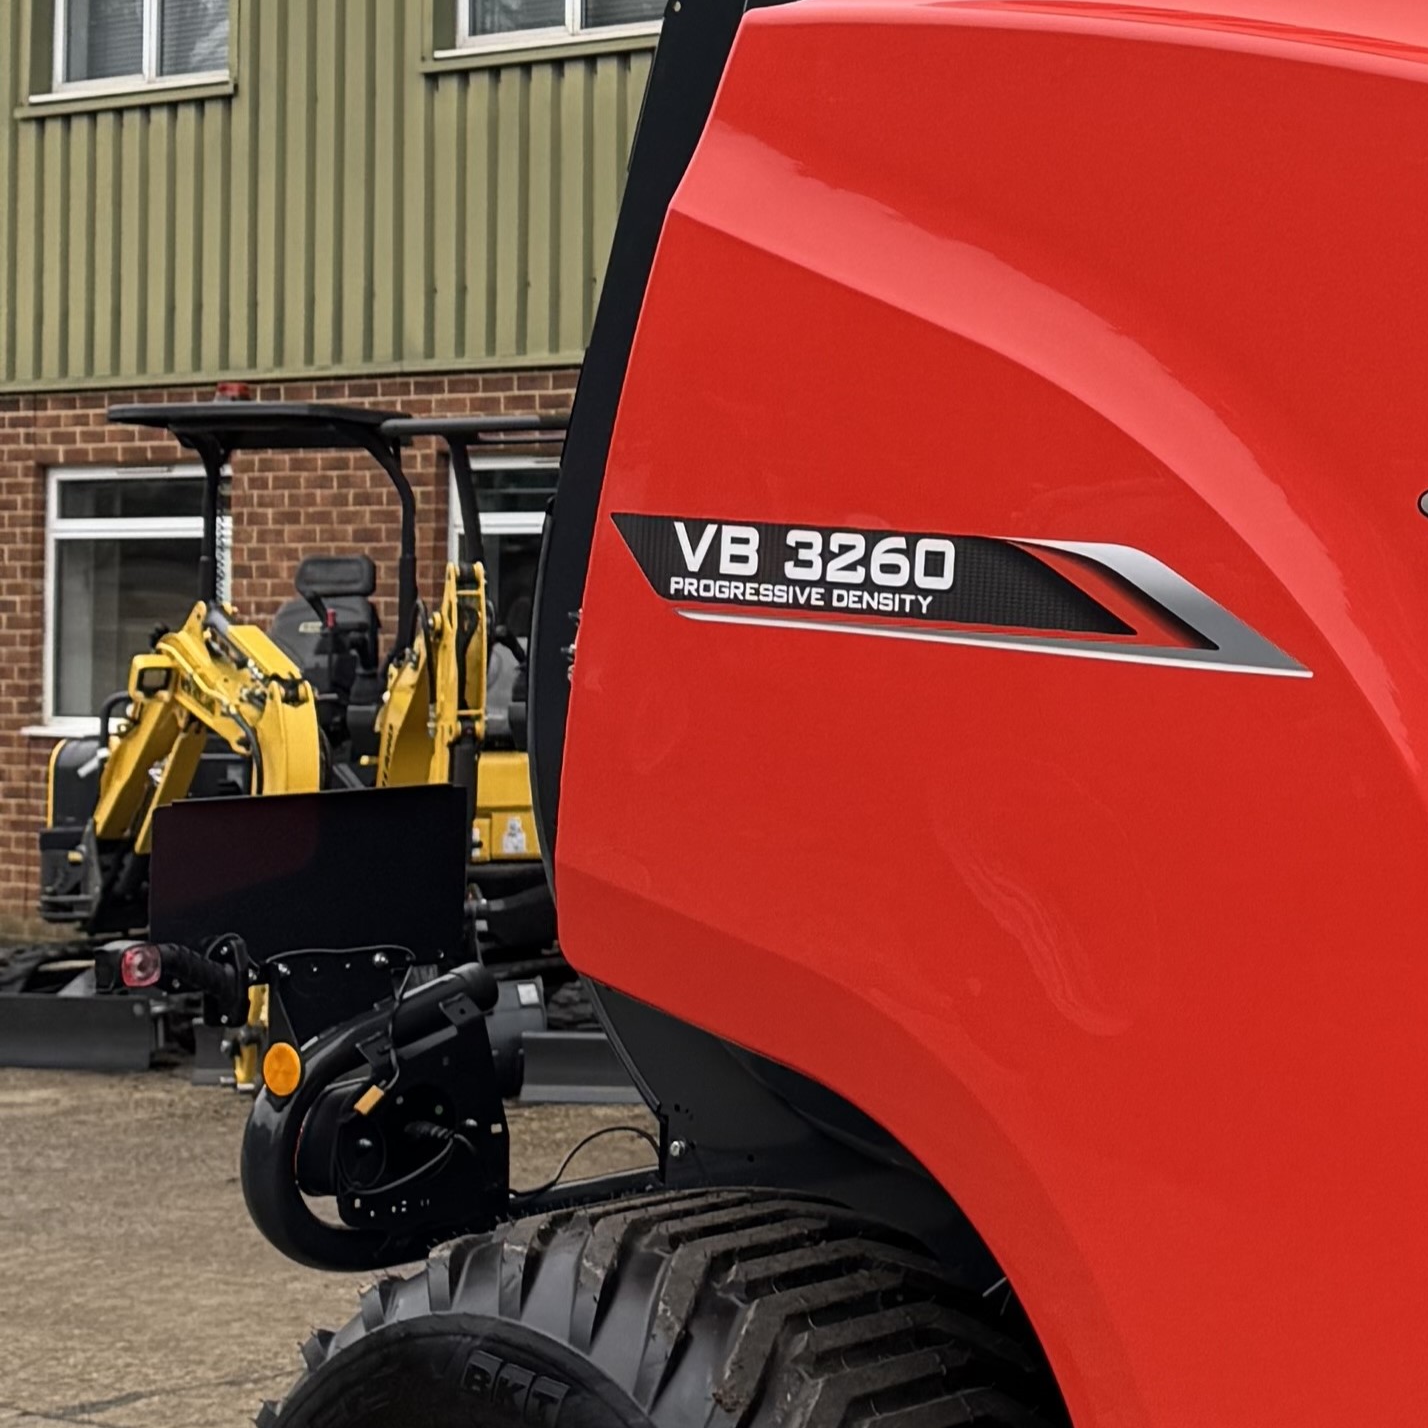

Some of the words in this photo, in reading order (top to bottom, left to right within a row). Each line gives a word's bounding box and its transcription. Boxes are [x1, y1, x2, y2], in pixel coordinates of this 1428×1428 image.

[673, 521, 760, 575] VB
[783, 529, 956, 590] 3260
[669, 577, 825, 606] PROGRESSIVE
[832, 588, 934, 614] DENSITY
